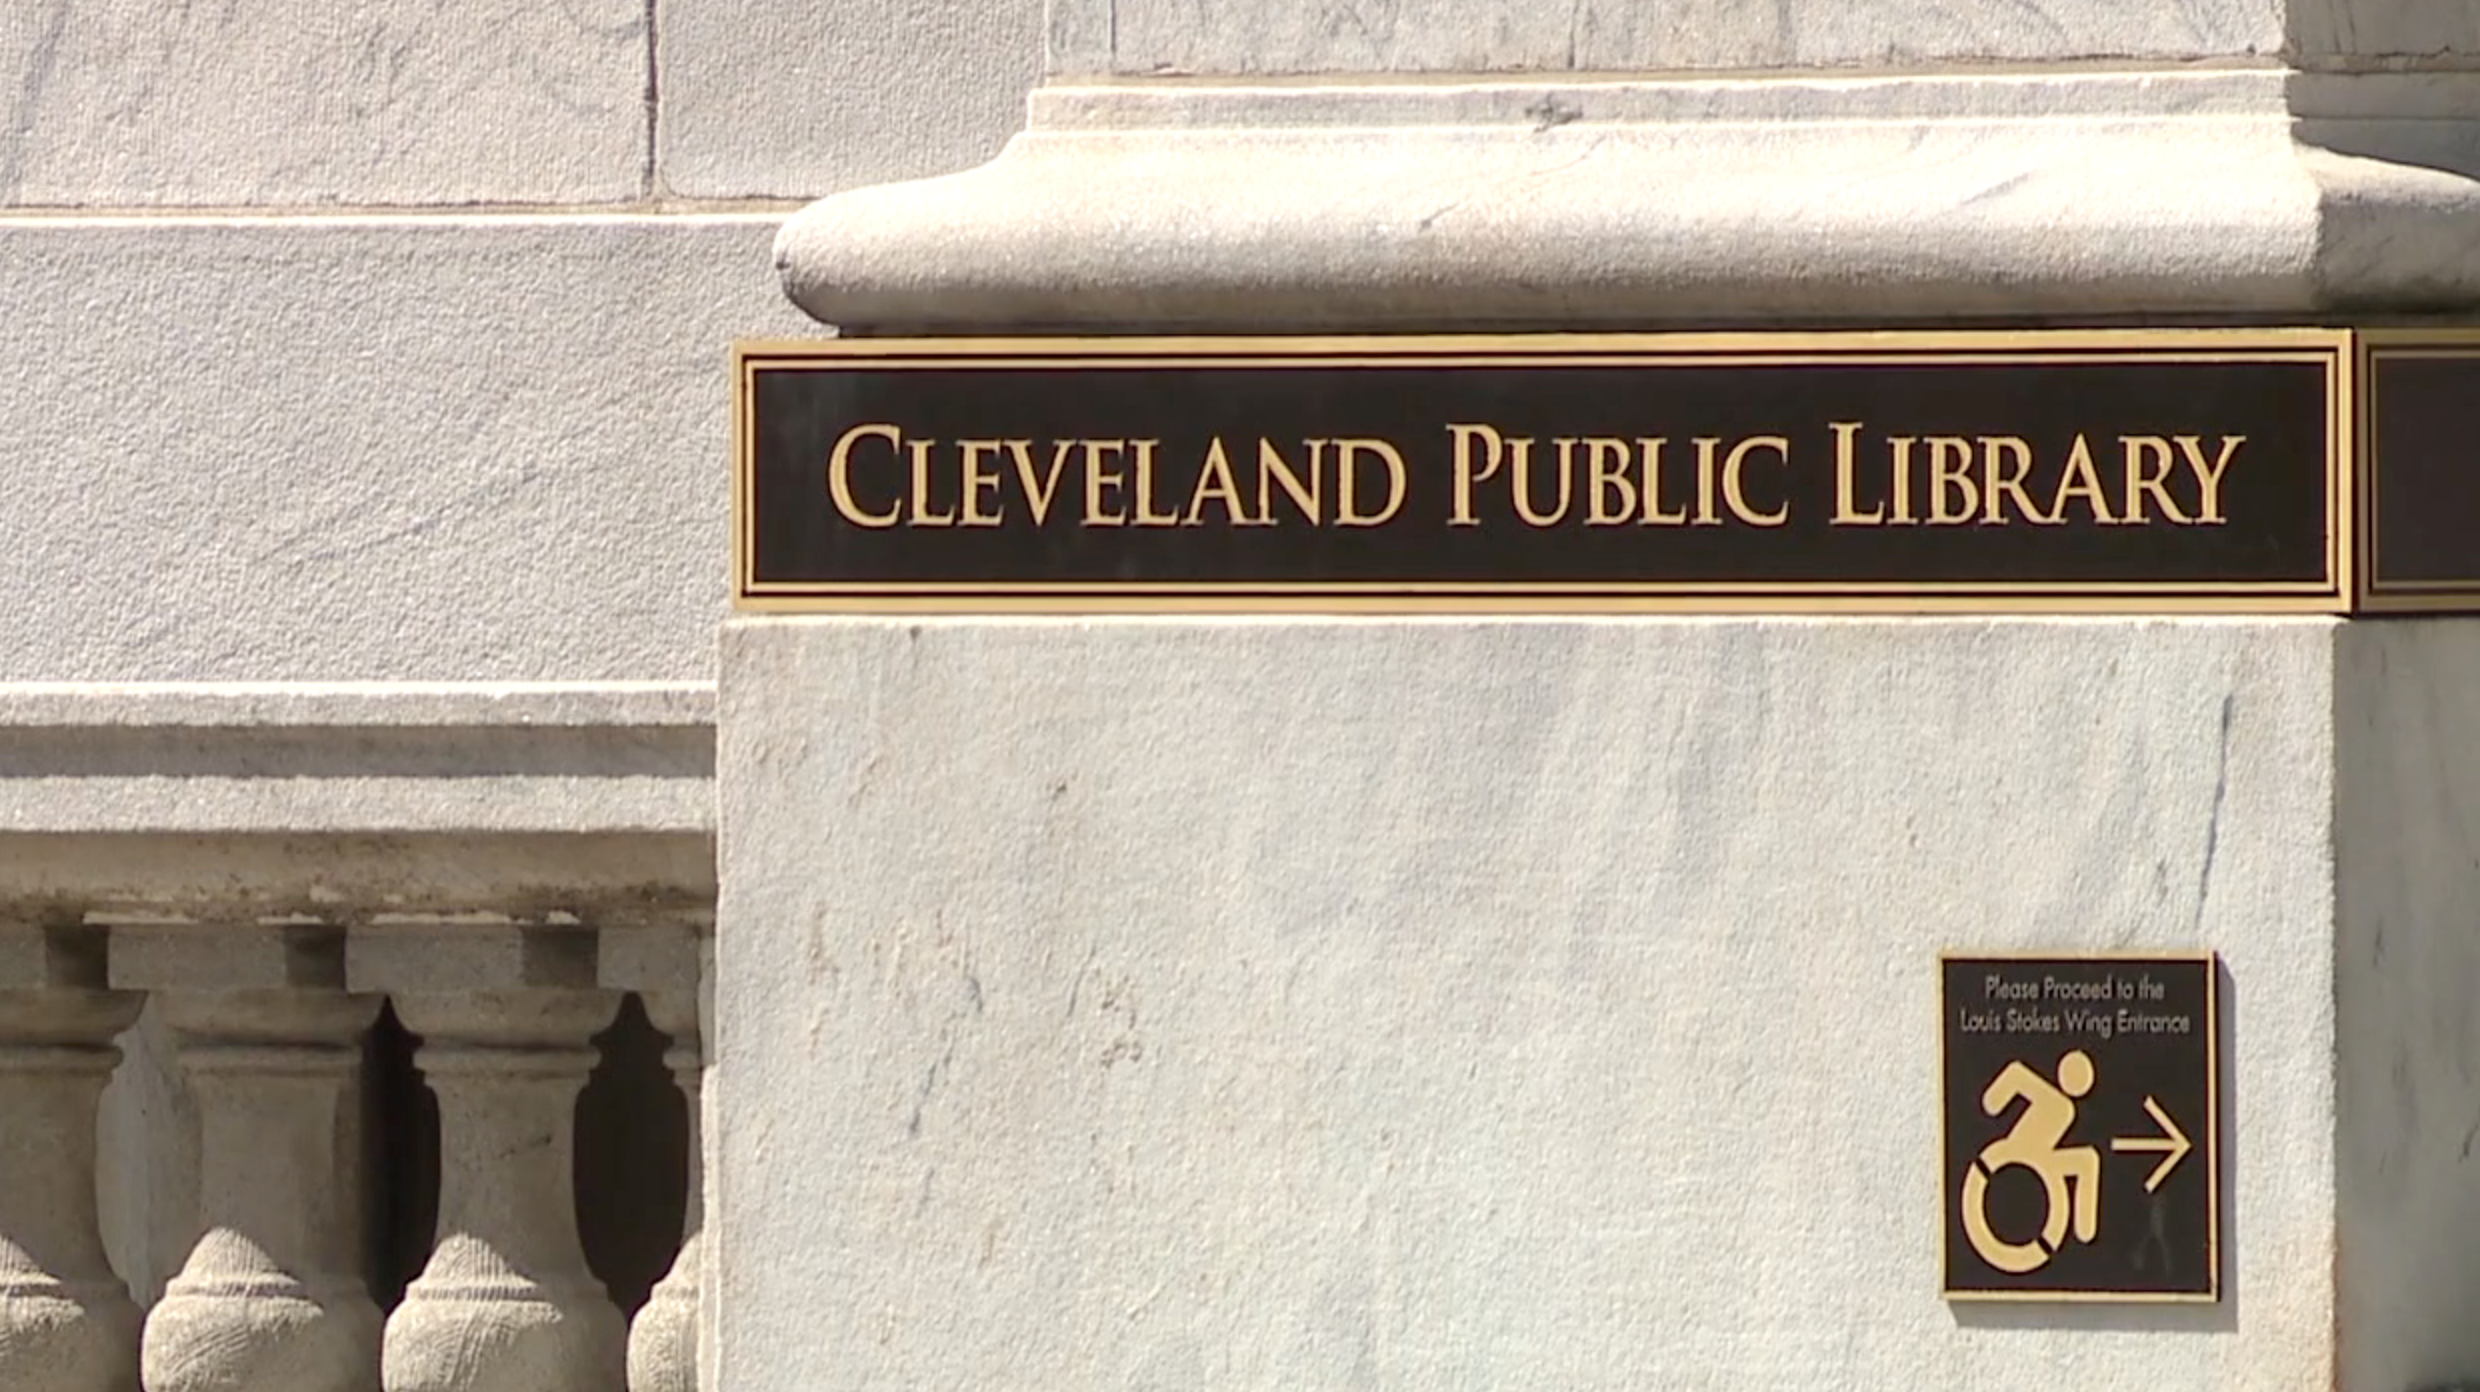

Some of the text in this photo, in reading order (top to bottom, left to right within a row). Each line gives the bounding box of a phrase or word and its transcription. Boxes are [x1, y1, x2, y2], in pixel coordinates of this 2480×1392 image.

[828, 421, 2246, 528] CLEVELAND PUBLIC LIBRARY
[1985, 975, 2165, 999] Please Proceed to the
[1961, 1008, 2191, 1038] Louis Stokes Wing Entrance
